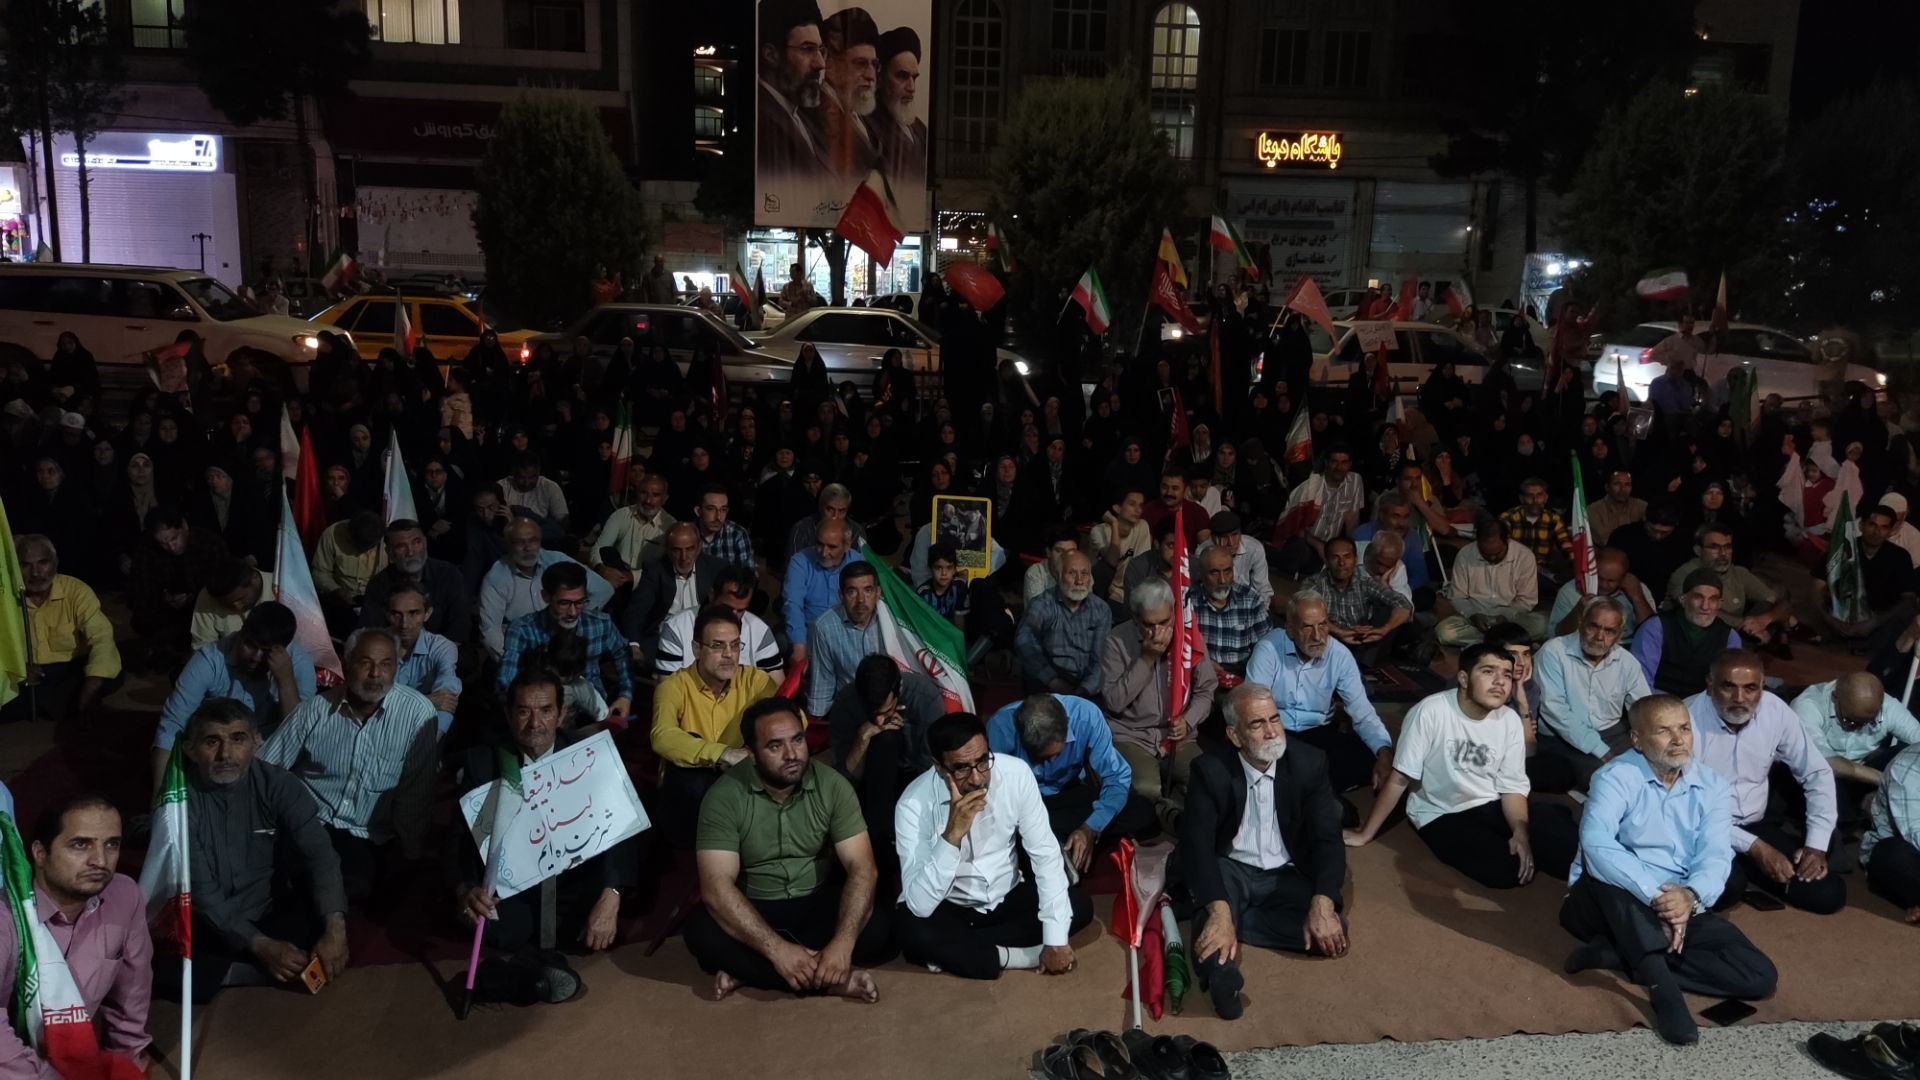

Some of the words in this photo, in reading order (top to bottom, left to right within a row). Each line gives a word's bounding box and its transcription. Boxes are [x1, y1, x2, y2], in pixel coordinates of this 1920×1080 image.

[413, 121, 475, 139] کوروش
[1290, 132, 1341, 170] باشگاه
[529, 793, 593, 844] لبنان
